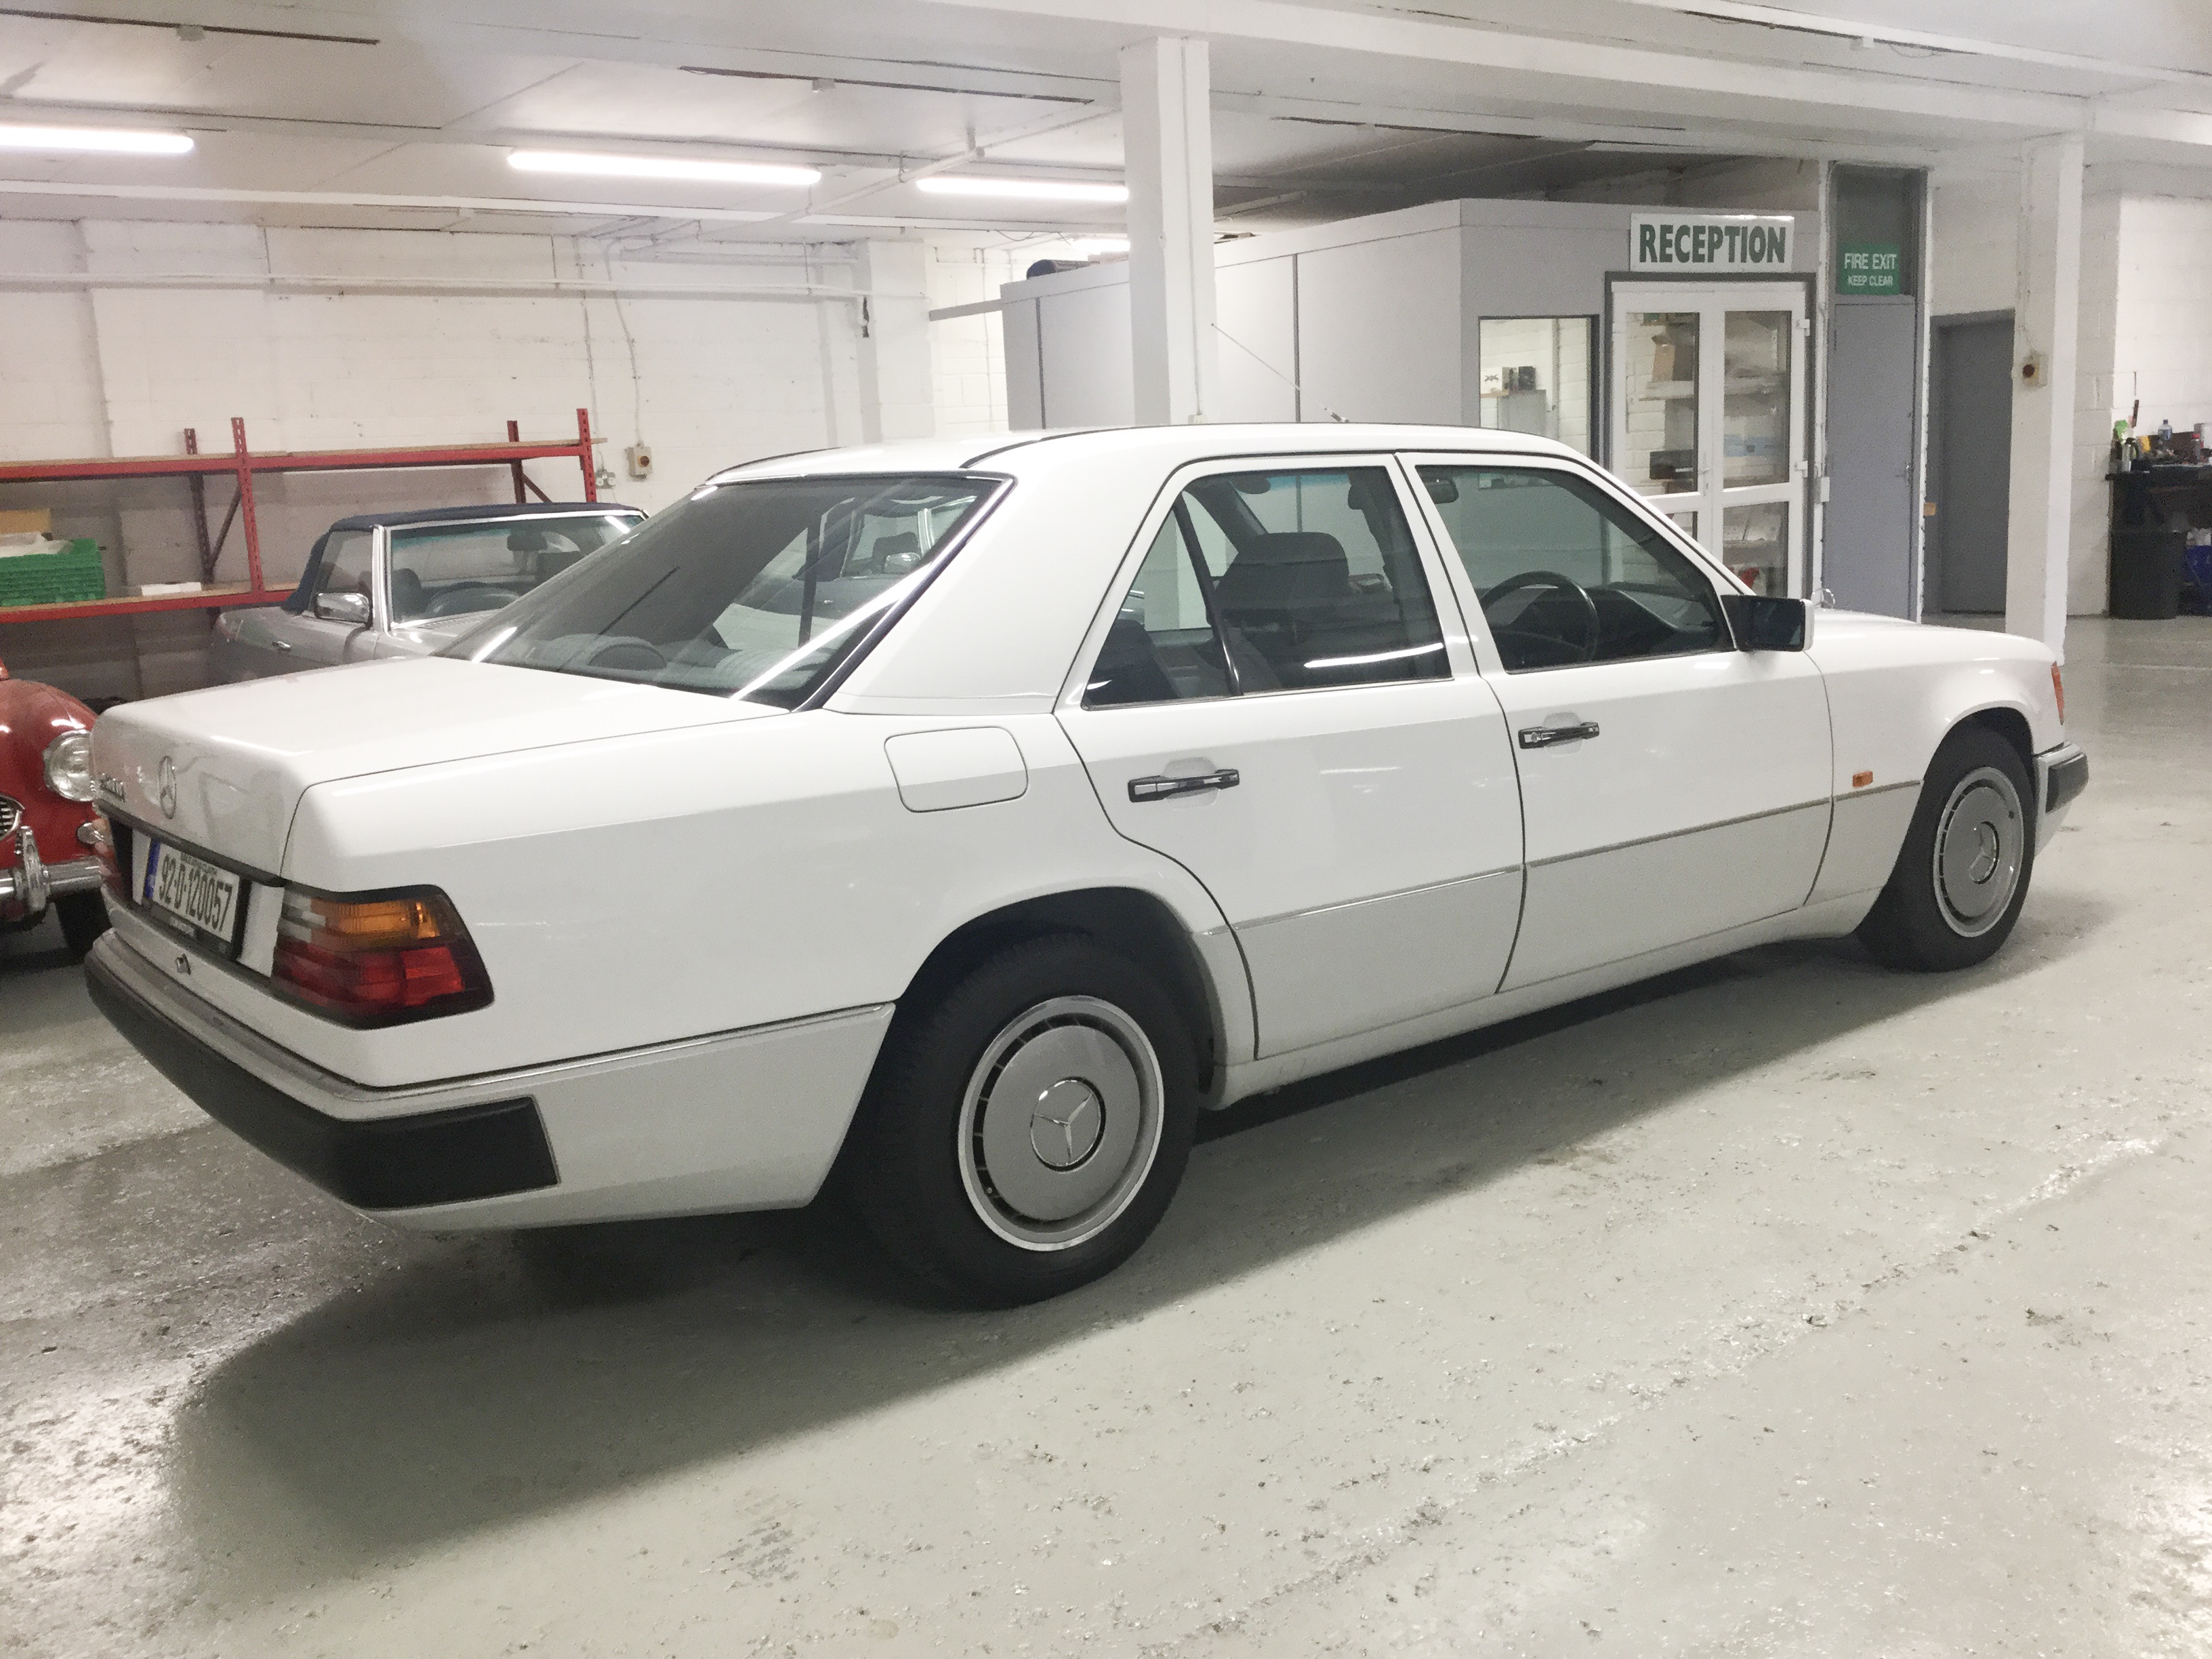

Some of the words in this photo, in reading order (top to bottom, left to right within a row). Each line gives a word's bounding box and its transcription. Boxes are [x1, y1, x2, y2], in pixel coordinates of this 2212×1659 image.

[1639, 224, 1786, 264] RECEPTION
[1844, 252, 1869, 270] FIRE
[1872, 253, 1898, 270] EXIT
[1847, 274, 1868, 287] KEEP
[1868, 274, 1893, 287] CLEAR
